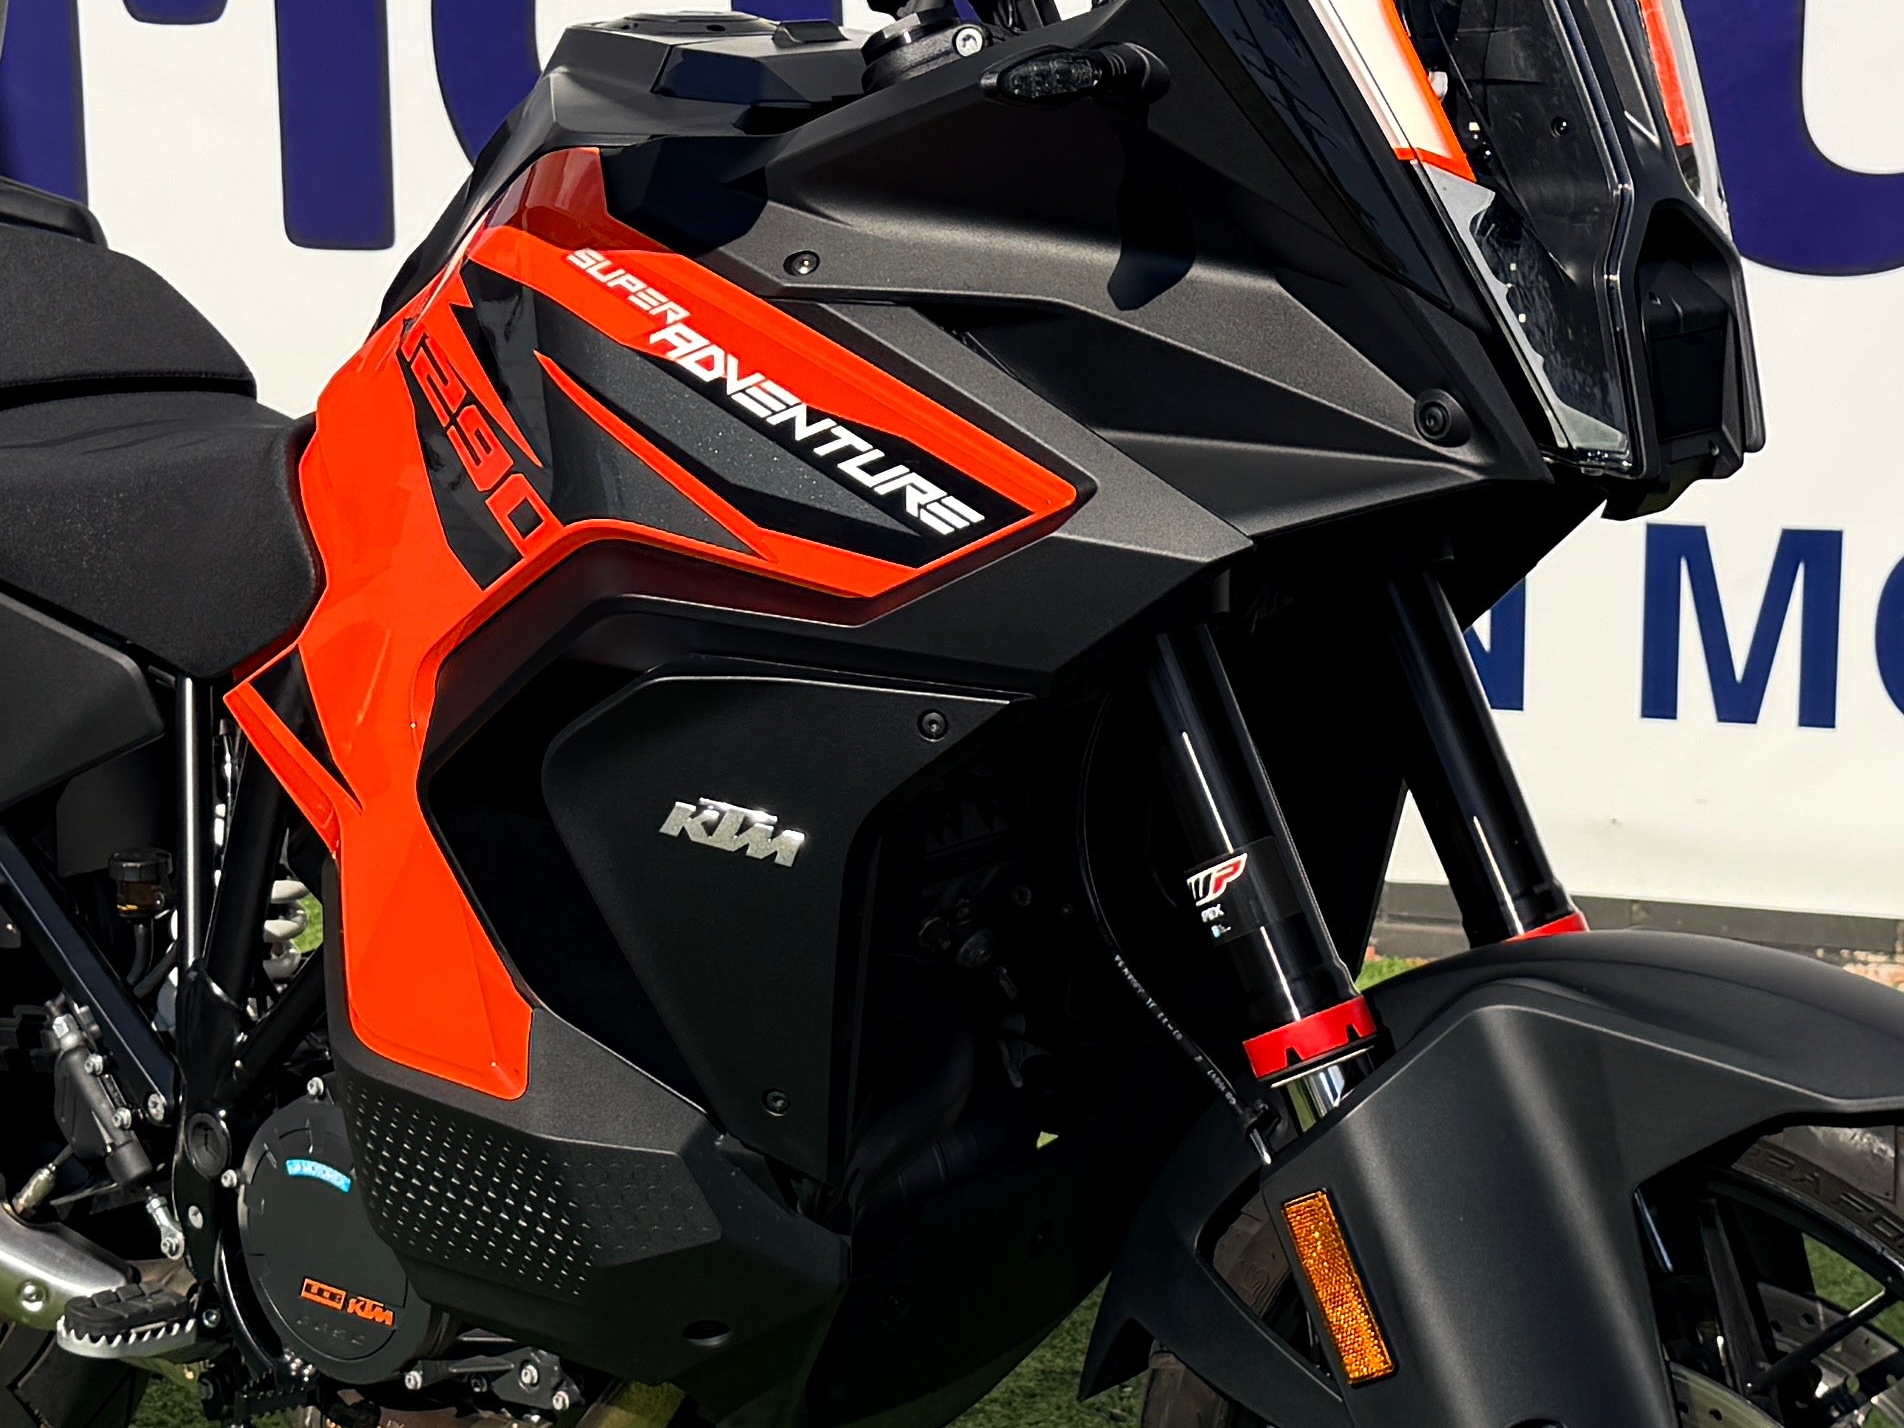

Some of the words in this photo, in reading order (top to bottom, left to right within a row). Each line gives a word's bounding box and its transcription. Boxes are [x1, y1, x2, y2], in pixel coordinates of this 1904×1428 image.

[566, 247, 693, 325] SUPER
[649, 323, 986, 536] ADVENTURE
[659, 797, 806, 868] KTM
[346, 1295, 396, 1327] KTM
